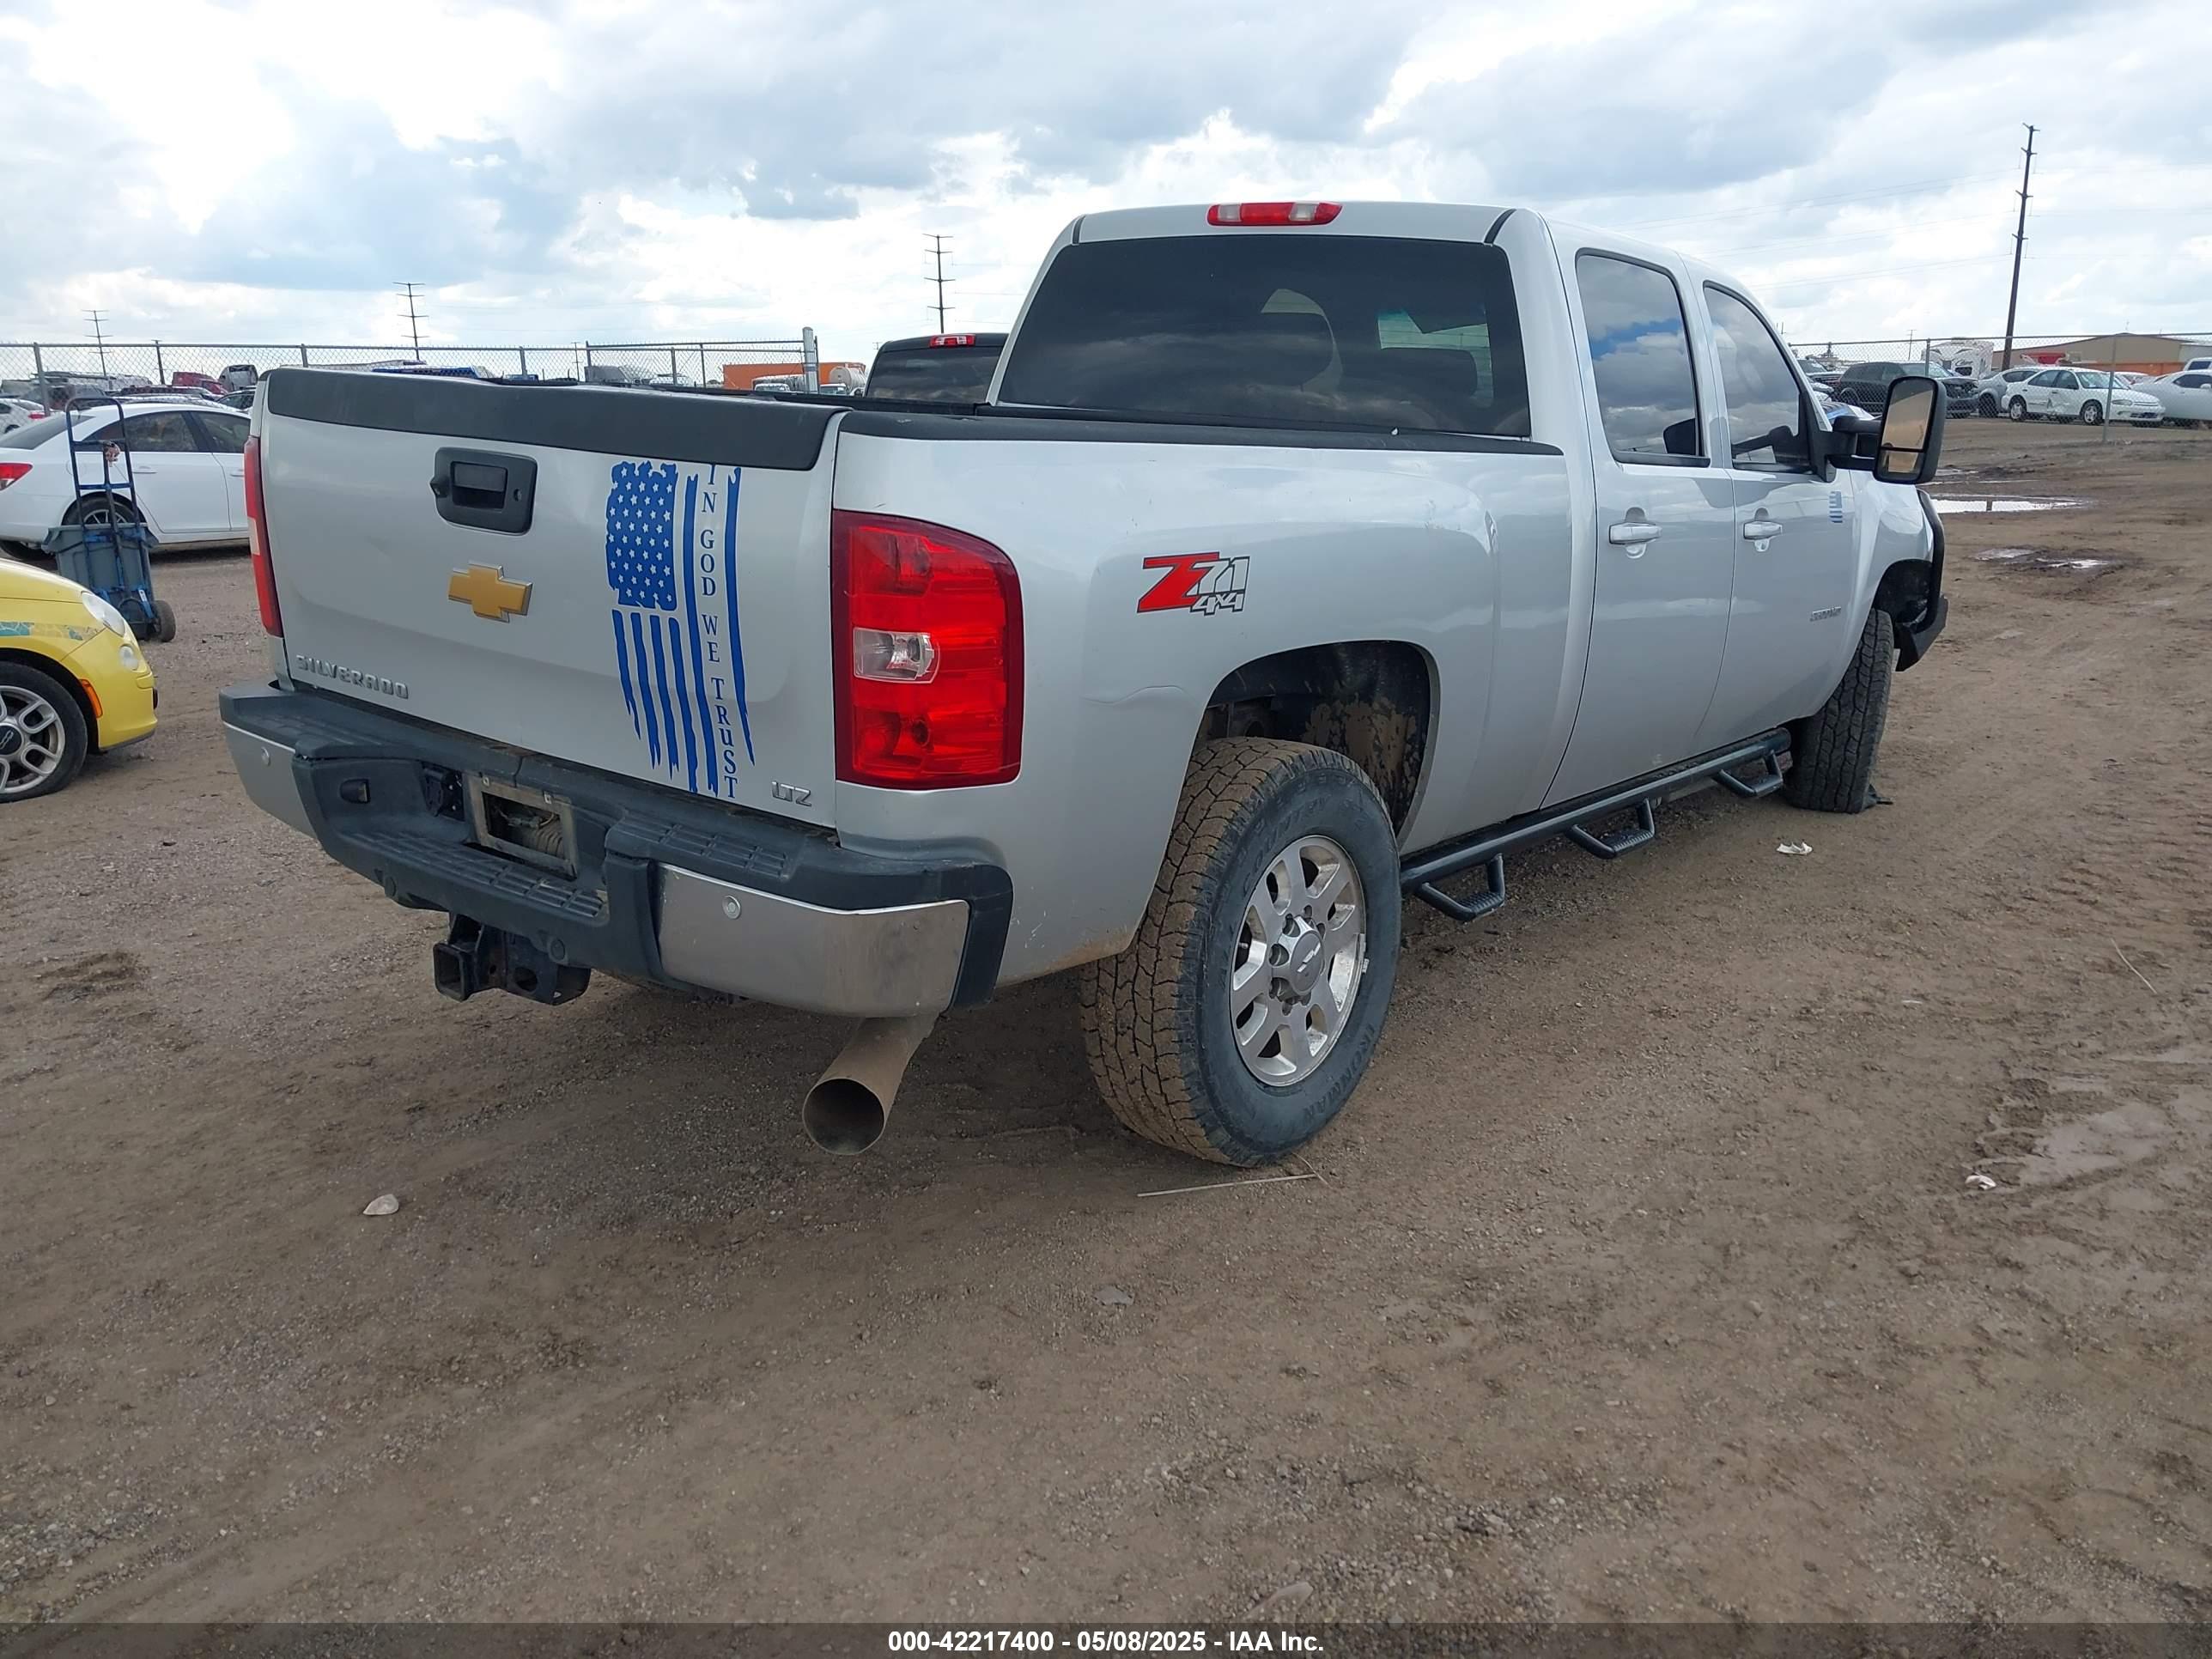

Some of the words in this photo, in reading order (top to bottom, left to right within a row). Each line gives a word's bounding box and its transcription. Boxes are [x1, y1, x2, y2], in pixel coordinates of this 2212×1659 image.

[702, 465, 717, 513] IN
[700, 529, 716, 596] GOD
[1137, 551, 1250, 613] Z71
[702, 614, 720, 662] WE
[295, 654, 409, 699] SILVERADO
[711, 677, 738, 799] TRUST
[772, 781, 812, 806] LTZ
